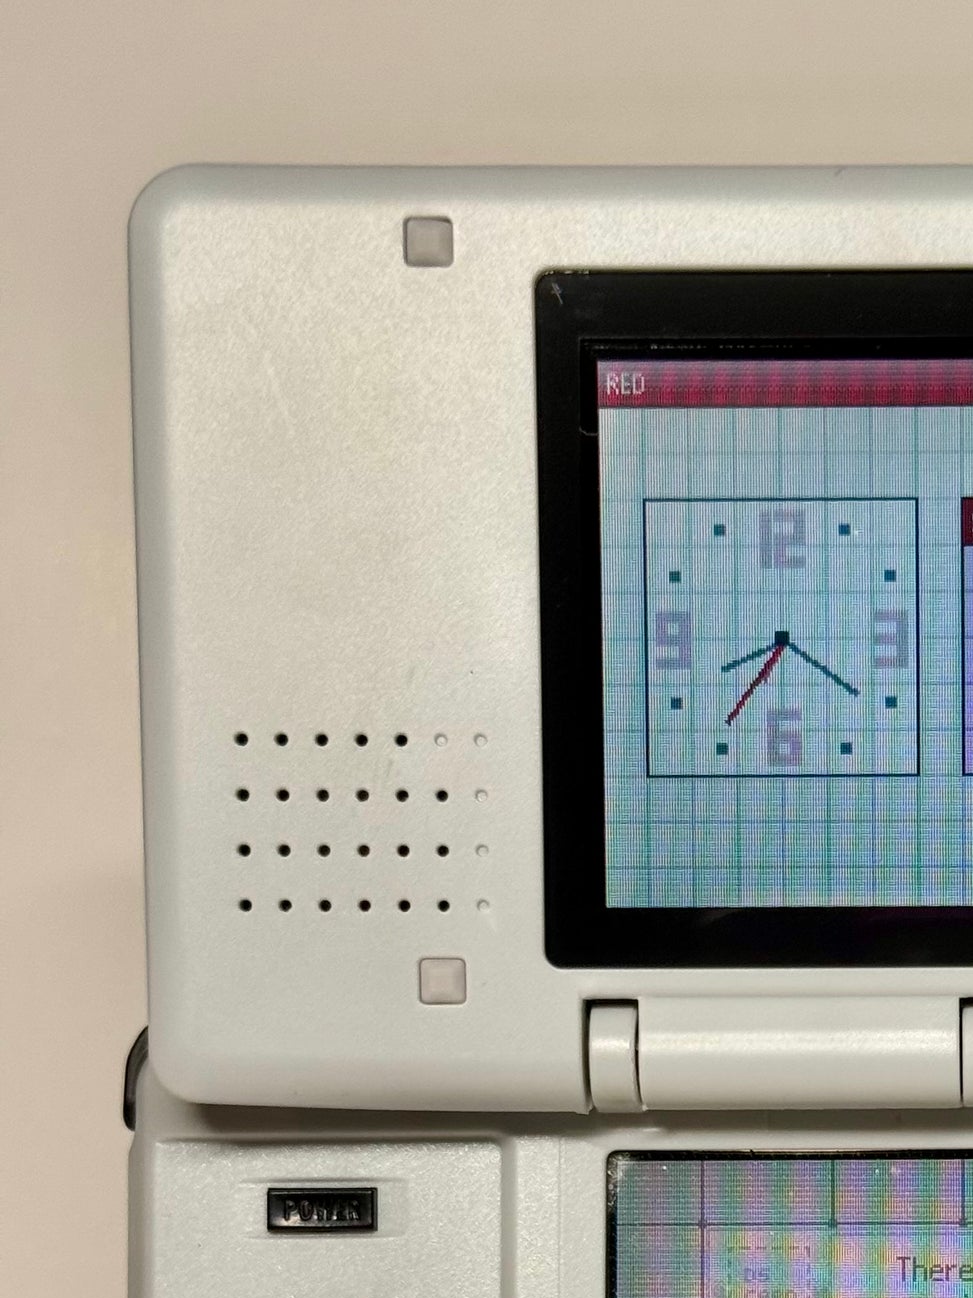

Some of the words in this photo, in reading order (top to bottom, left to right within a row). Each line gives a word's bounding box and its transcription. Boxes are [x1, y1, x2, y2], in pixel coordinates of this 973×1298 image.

[607, 373, 645, 395] RED
[759, 510, 806, 569] 12
[656, 612, 691, 669] 9
[874, 609, 908, 668] 3
[766, 709, 801, 766] 6
[897, 1256, 973, 1281] There
